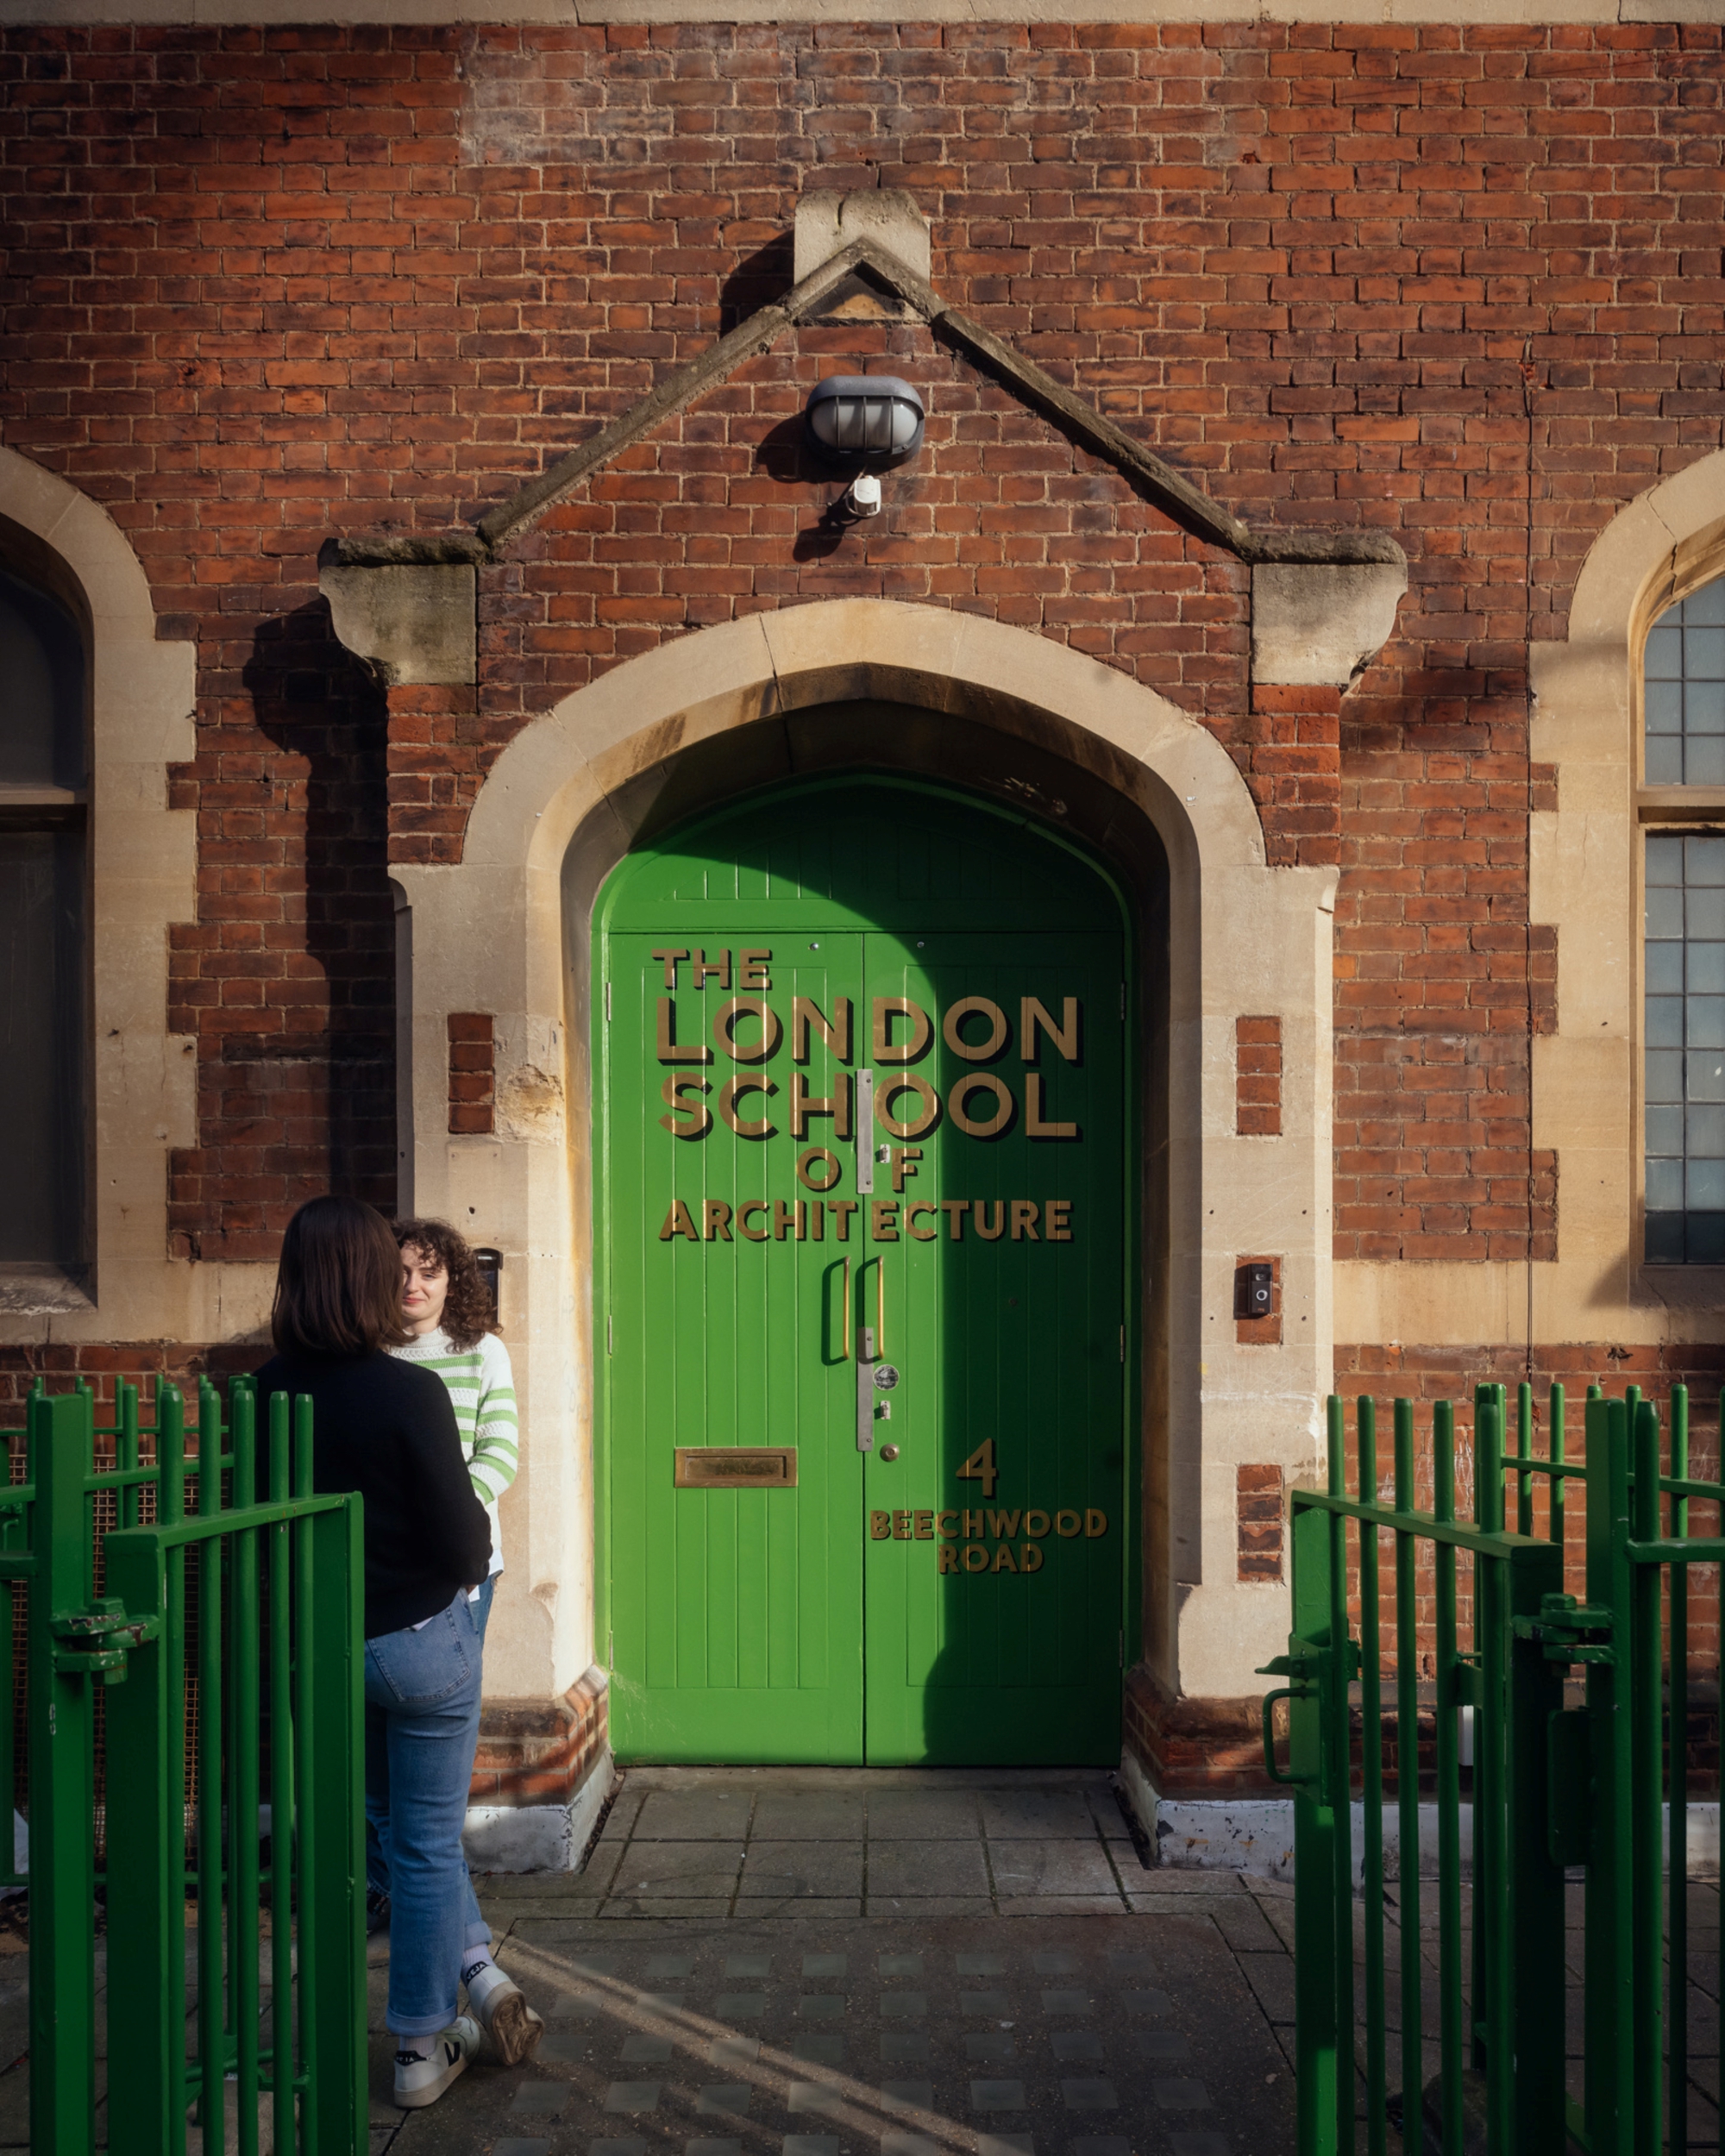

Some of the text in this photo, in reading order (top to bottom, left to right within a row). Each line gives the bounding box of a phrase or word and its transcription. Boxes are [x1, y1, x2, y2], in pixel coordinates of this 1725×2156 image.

[652, 949, 772, 990] THE
[656, 996, 1082, 1067] LONDON
[658, 1072, 1082, 1143] SCHOOL
[797, 1146, 923, 1194] OF
[659, 1200, 1074, 1242] ARCHITECTURE
[956, 1438, 999, 1500] 4
[869, 1508, 1109, 1541] BEECHWOOD
[938, 1544, 1044, 1575] ROAD
[467, 1963, 486, 1979] VEJA
